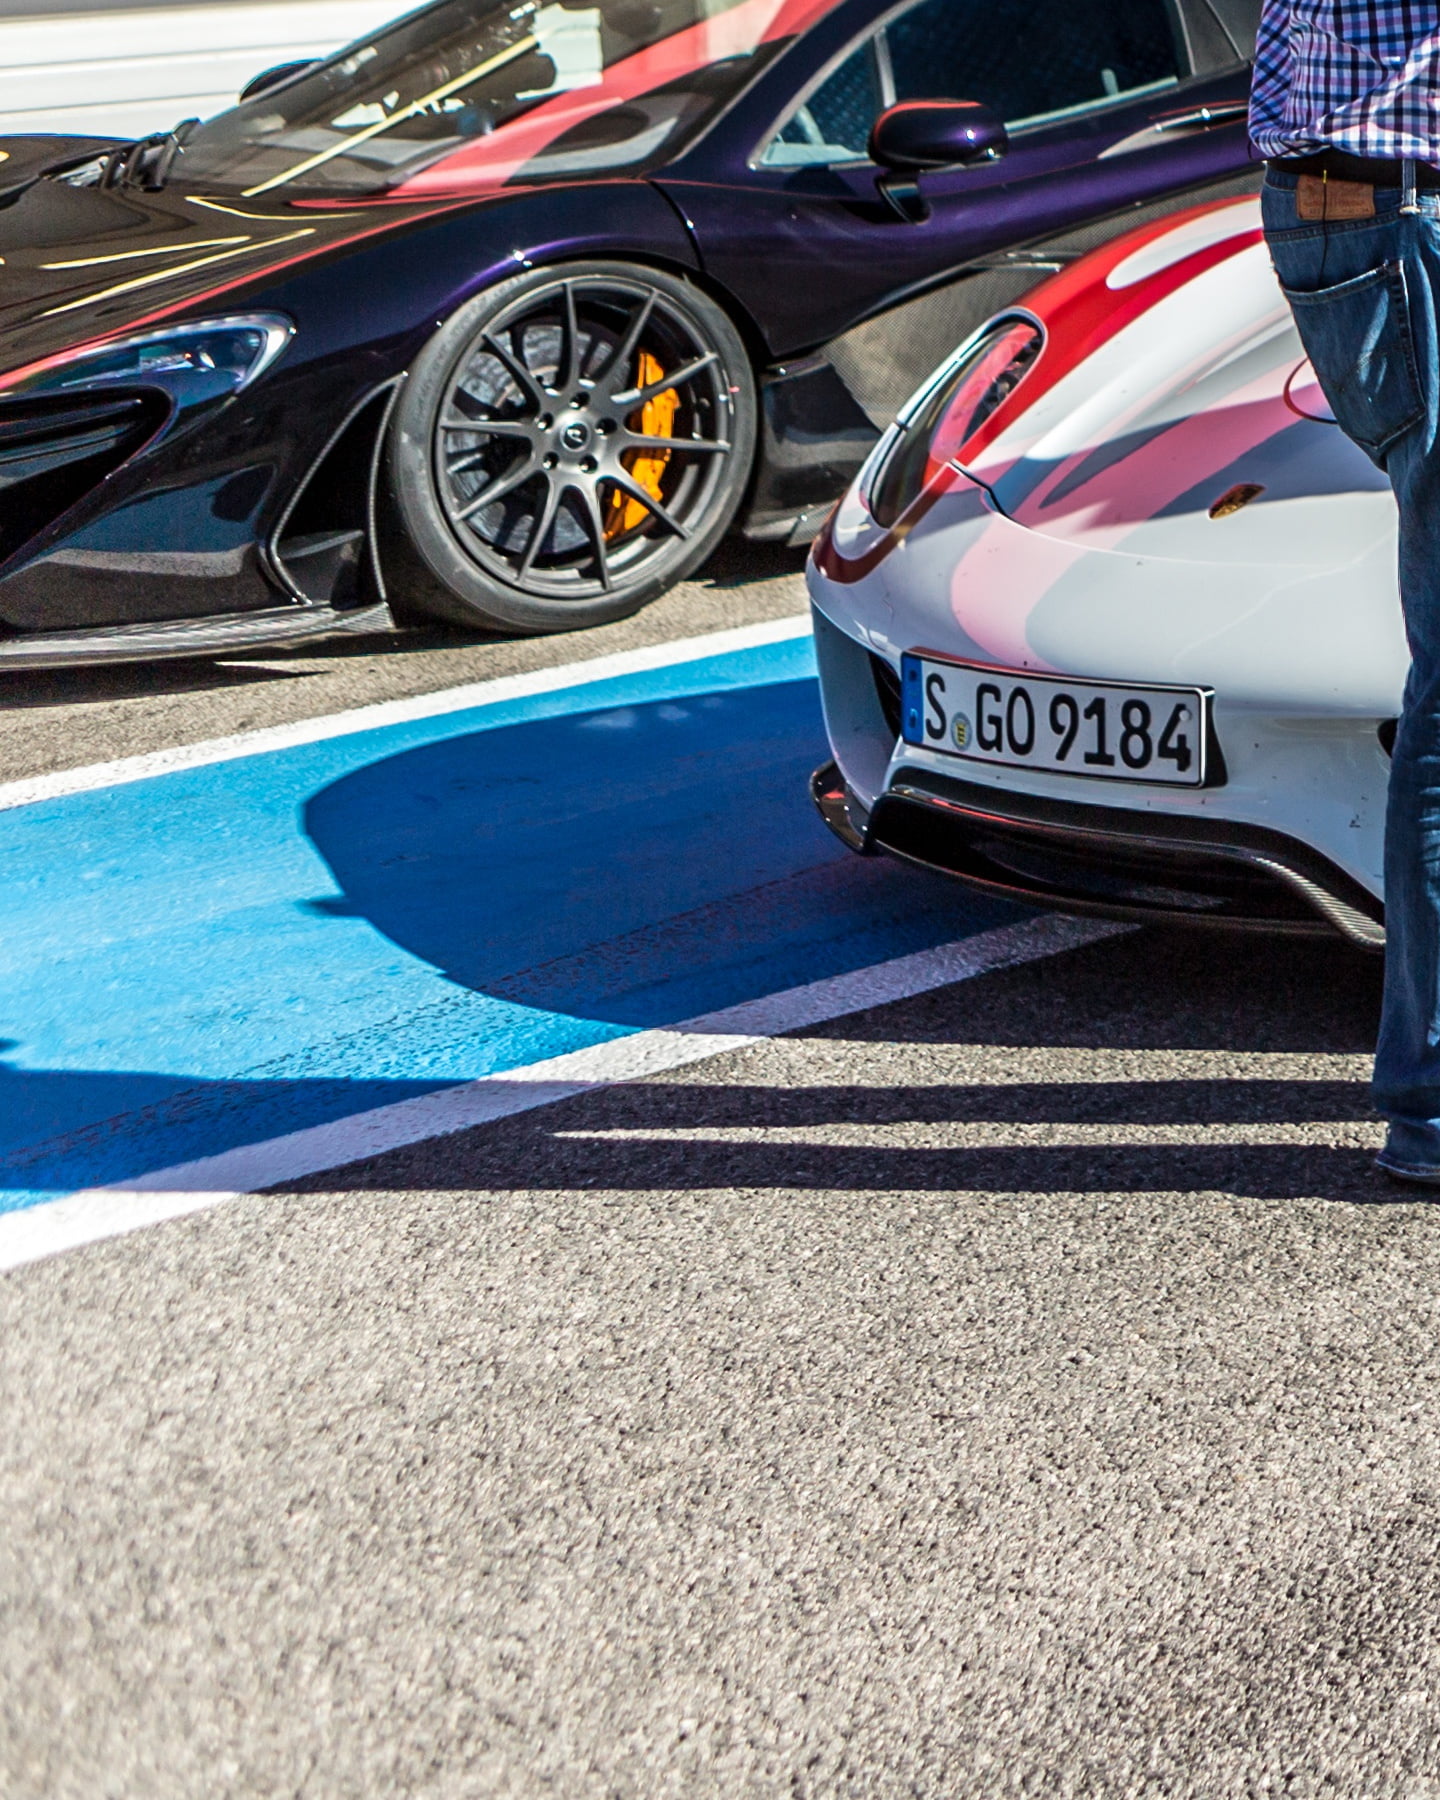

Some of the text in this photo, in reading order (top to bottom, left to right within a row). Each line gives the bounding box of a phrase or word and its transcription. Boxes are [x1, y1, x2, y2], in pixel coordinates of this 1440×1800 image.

[925, 672, 1193, 772] S GO 9184
